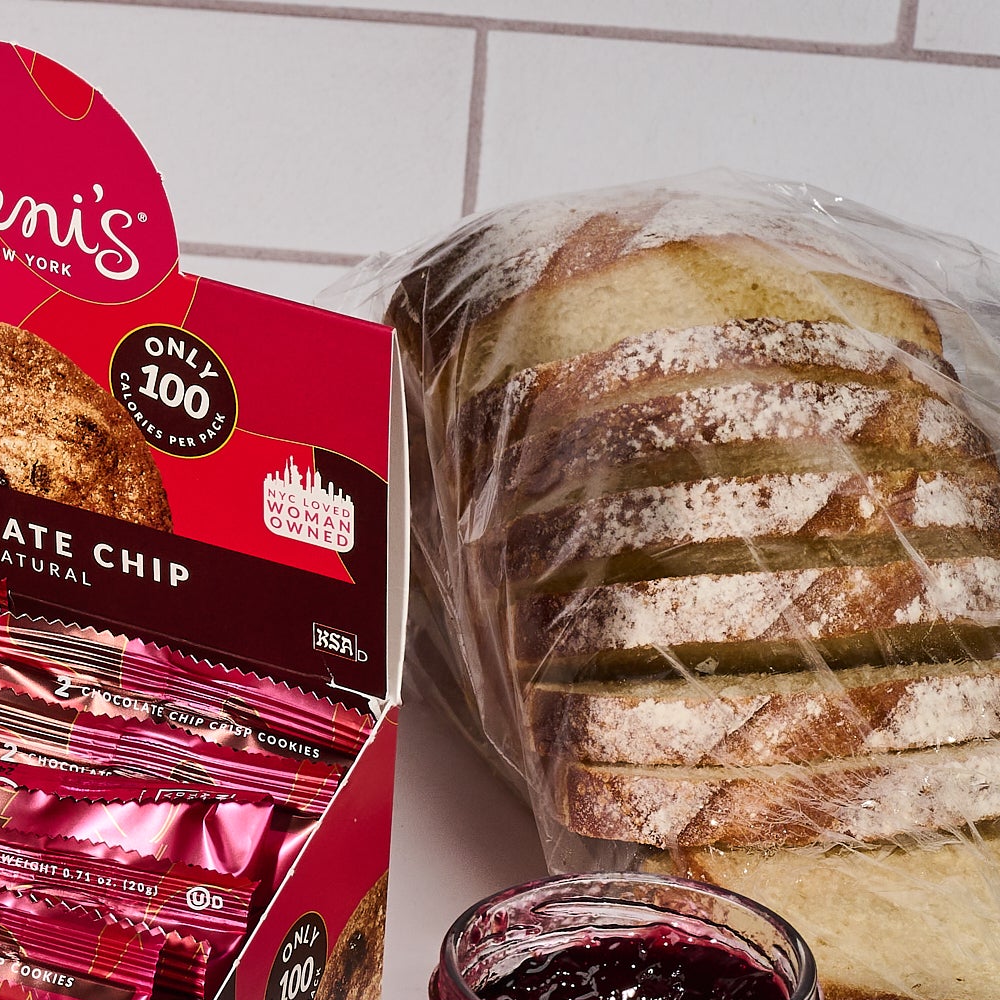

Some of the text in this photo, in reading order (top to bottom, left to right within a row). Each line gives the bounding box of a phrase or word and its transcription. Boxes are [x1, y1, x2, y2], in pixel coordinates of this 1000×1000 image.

[24, 253, 73, 278] YORK
[144, 335, 220, 382] ONLY
[119, 371, 227, 449] CALORIES PER PACK
[139, 364, 211, 420] 100
[267, 500, 351, 534] WOMAN
[268, 488, 351, 518] NYC LOVED
[269, 516, 349, 547] OWNED
[92, 543, 190, 588] CHIP
[54, 675, 320, 759] 2 CHOCOLATE CHIP CRISP COOKIES
[0, 742, 18, 763] 2
[1, 852, 59, 877] WEIGHT
[62, 867, 90, 882] 0.71
[98, 877, 117, 888] oz.
[122, 878, 158, 897] (20g)
[282, 924, 320, 963] ONLY
[10, 962, 75, 989] COOKIES
